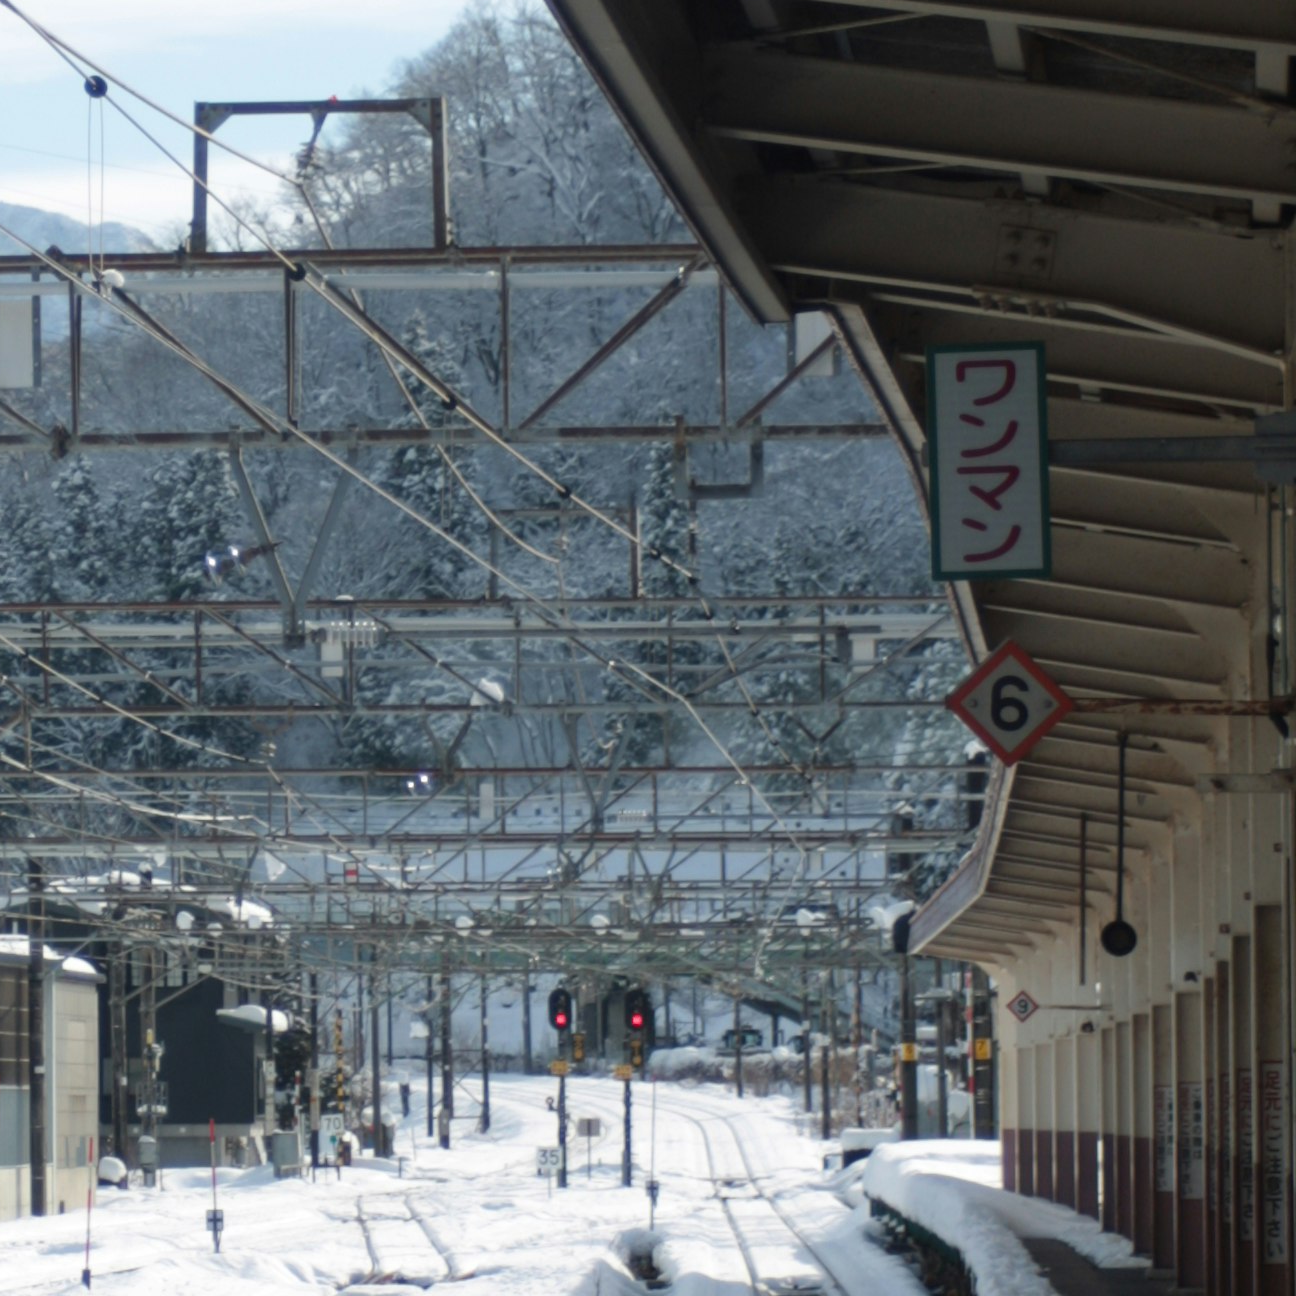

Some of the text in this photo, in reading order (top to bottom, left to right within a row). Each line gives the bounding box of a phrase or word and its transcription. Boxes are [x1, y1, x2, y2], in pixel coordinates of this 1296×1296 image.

[955, 359, 1021, 563] ワンマン
[990, 675, 1029, 731] 6
[1018, 999, 1028, 1014] 9
[325, 1117, 341, 1131] 70
[538, 1149, 559, 1166] 35
